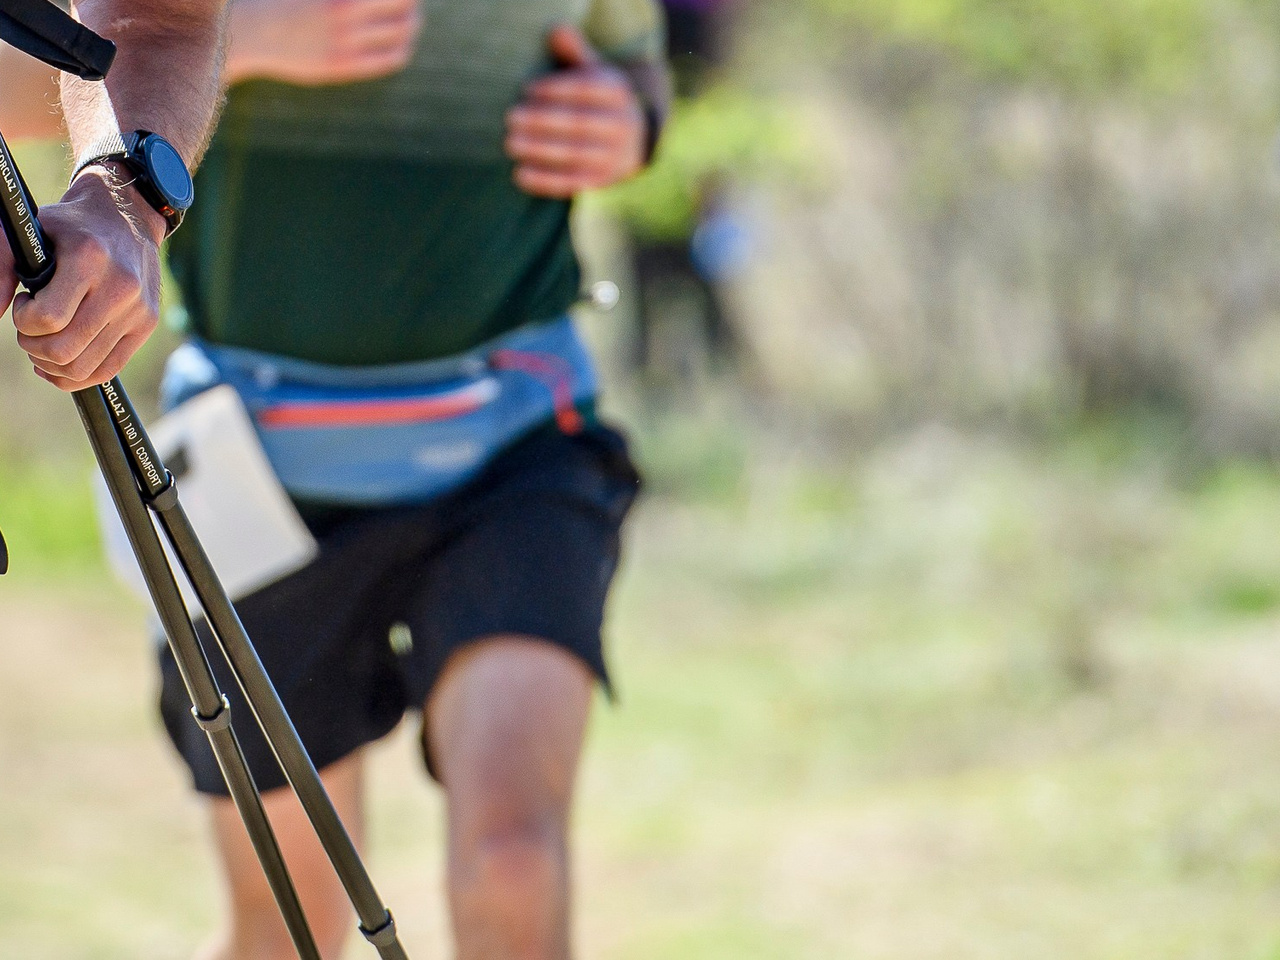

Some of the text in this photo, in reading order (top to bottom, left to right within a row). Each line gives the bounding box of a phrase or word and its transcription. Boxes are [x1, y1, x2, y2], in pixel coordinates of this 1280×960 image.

[15, 198, 26, 216] 100
[24, 222, 46, 264] COMFORT
[102, 380, 162, 487] ORCLAZ 100 COMFORT
